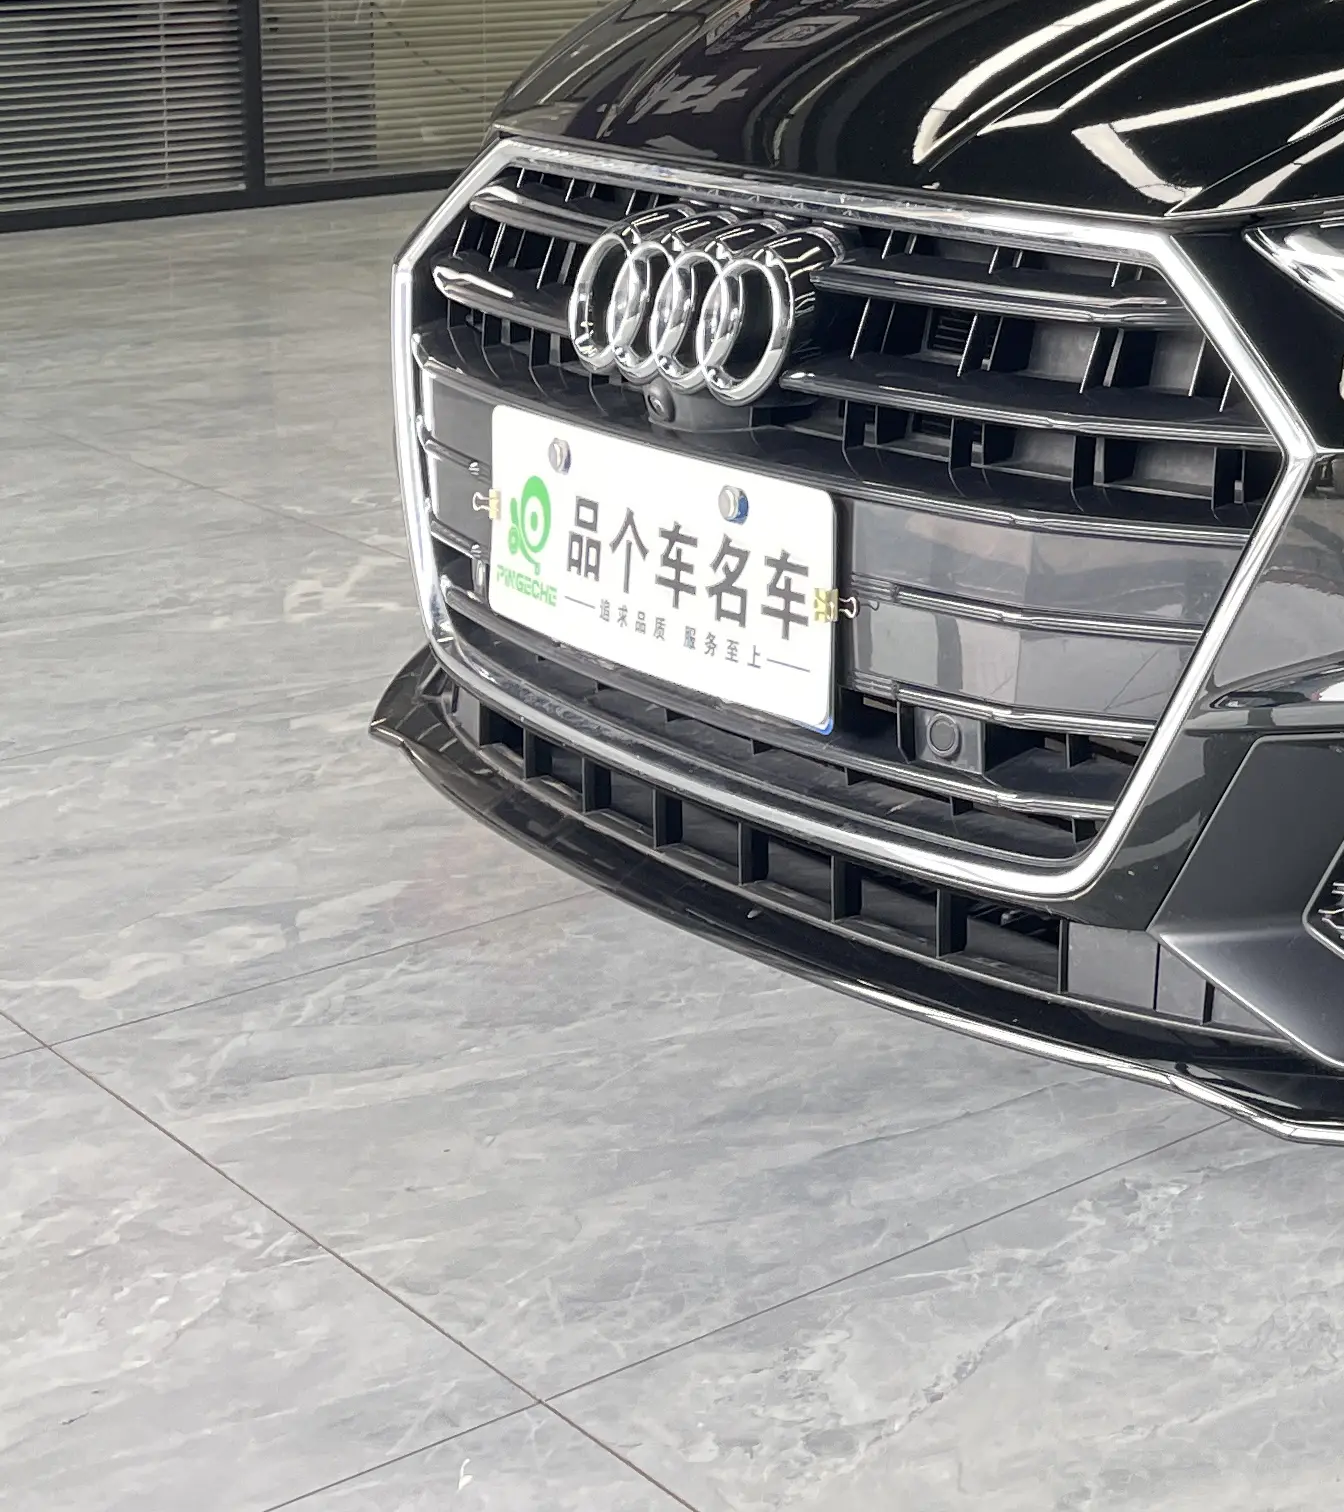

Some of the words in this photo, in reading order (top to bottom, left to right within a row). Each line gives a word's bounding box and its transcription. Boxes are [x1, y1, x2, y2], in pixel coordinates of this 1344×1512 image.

[567, 496, 810, 640] 品个车名车
[599, 599, 666, 641] 追求品质
[683, 626, 762, 669] 服务至上
